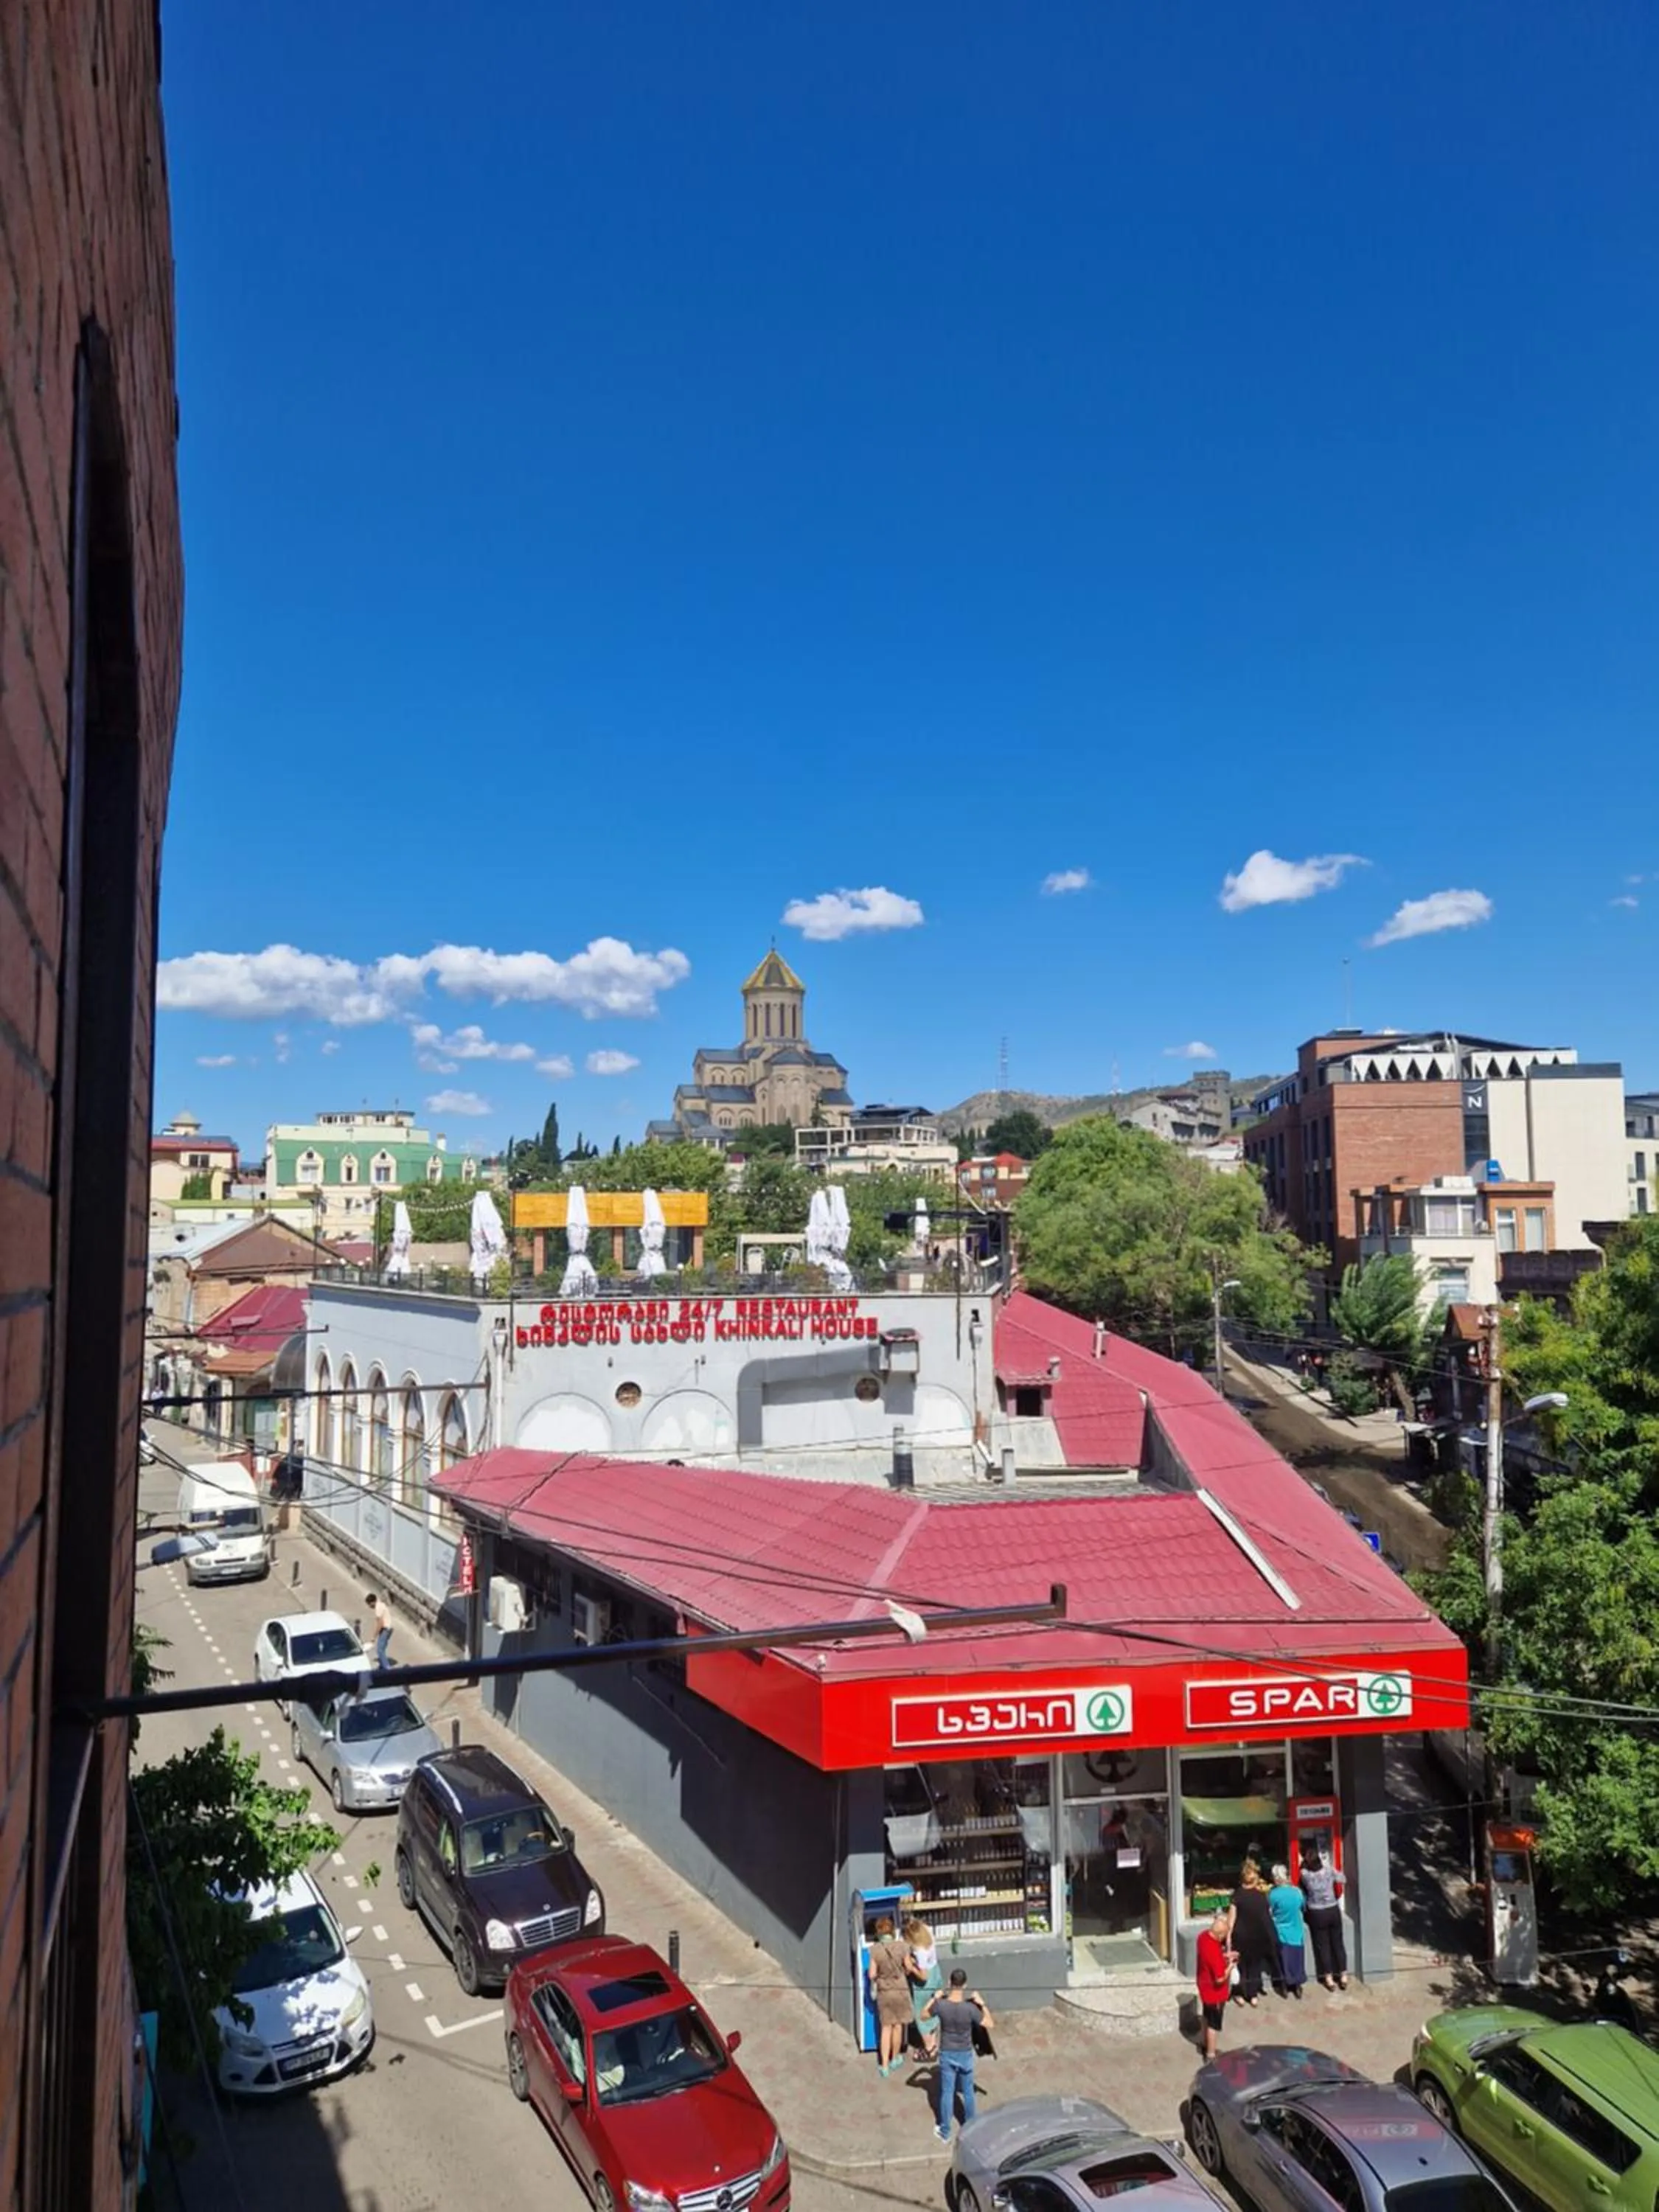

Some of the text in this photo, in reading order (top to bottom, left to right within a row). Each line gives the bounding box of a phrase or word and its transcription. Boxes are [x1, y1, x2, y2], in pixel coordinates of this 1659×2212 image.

[679, 1298, 726, 1322] 24/7
[735, 1297, 859, 1318] RESTAURANT
[714, 1317, 804, 1342] KHINKALI
[812, 1315, 879, 1340] HOUSE
[1229, 1685, 1356, 1717] SPAR
